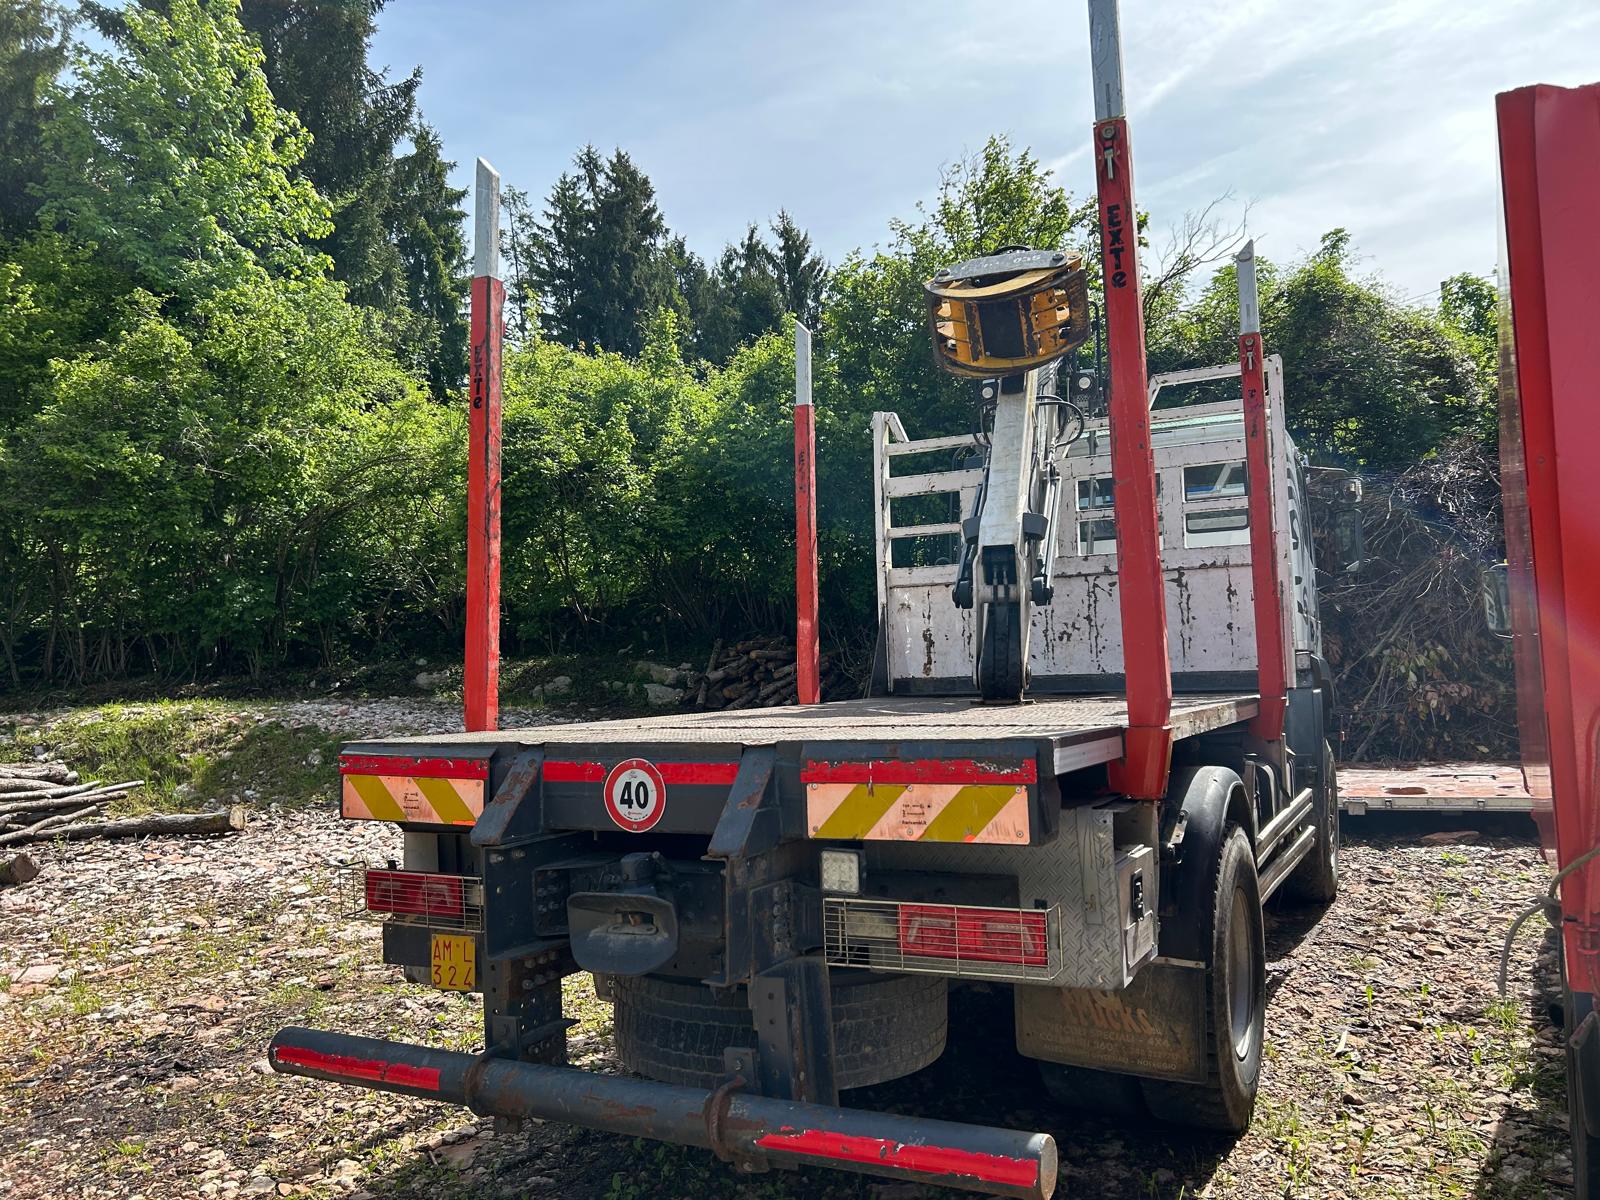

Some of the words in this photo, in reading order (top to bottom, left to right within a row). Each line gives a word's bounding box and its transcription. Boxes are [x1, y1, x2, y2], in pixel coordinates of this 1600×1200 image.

[620, 781, 649, 809] 40
[433, 940, 452, 961] AM
[463, 941, 472, 963] L
